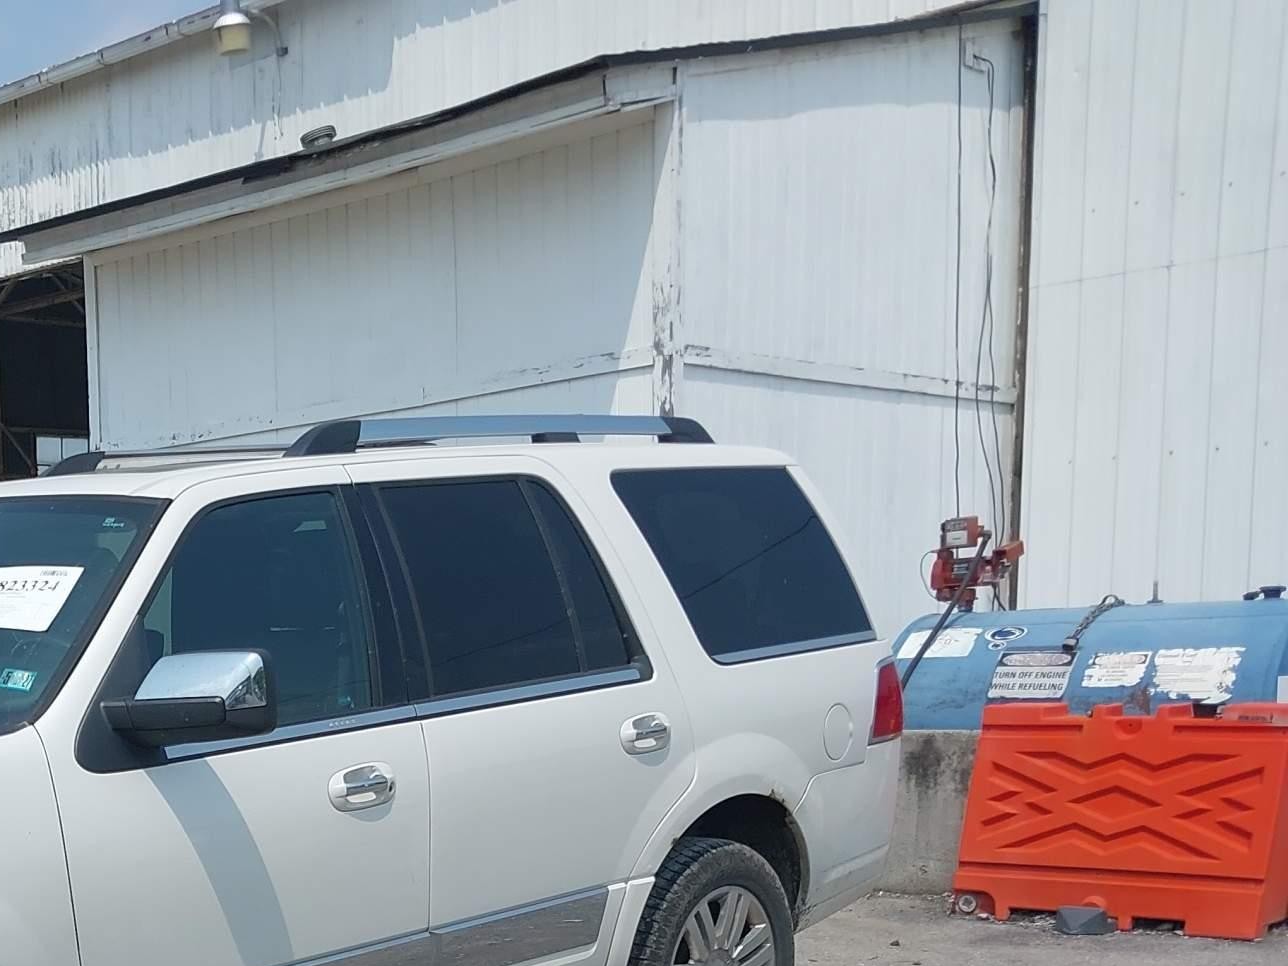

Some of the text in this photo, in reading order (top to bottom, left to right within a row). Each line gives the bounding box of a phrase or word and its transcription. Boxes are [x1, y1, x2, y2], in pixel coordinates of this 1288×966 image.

[994, 671, 1069, 679] TURN OFF ENGINE
[992, 682, 1064, 691] WHILE REFUELING
